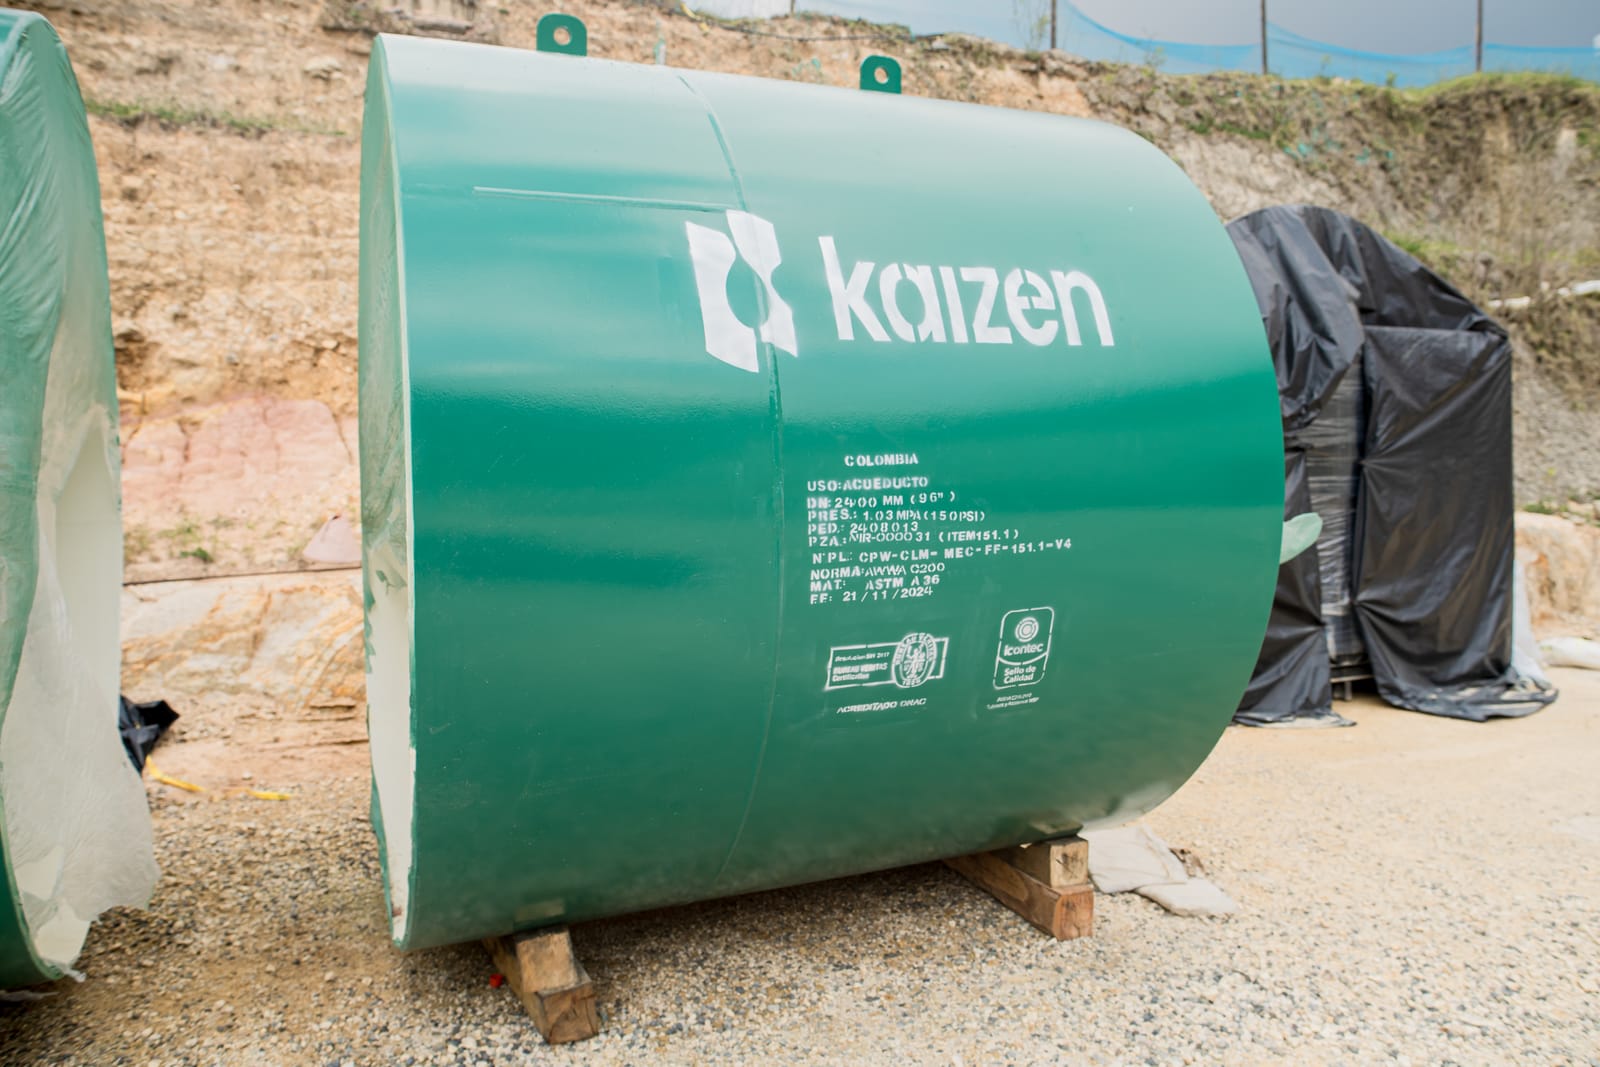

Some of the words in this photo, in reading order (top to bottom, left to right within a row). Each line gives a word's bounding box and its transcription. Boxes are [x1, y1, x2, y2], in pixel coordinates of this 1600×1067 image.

[818, 235, 1115, 346] kaizen
[844, 453, 919, 467] COLOMBIA
[882, 495, 904, 506] MM
[910, 562, 945, 574] C200
[865, 577, 904, 591] ASTM
[1004, 667, 1025, 677] Sello
[1026, 665, 1037, 674] de
[1003, 673, 1034, 685] Calidad
[836, 701, 898, 714] ACREDITADO
